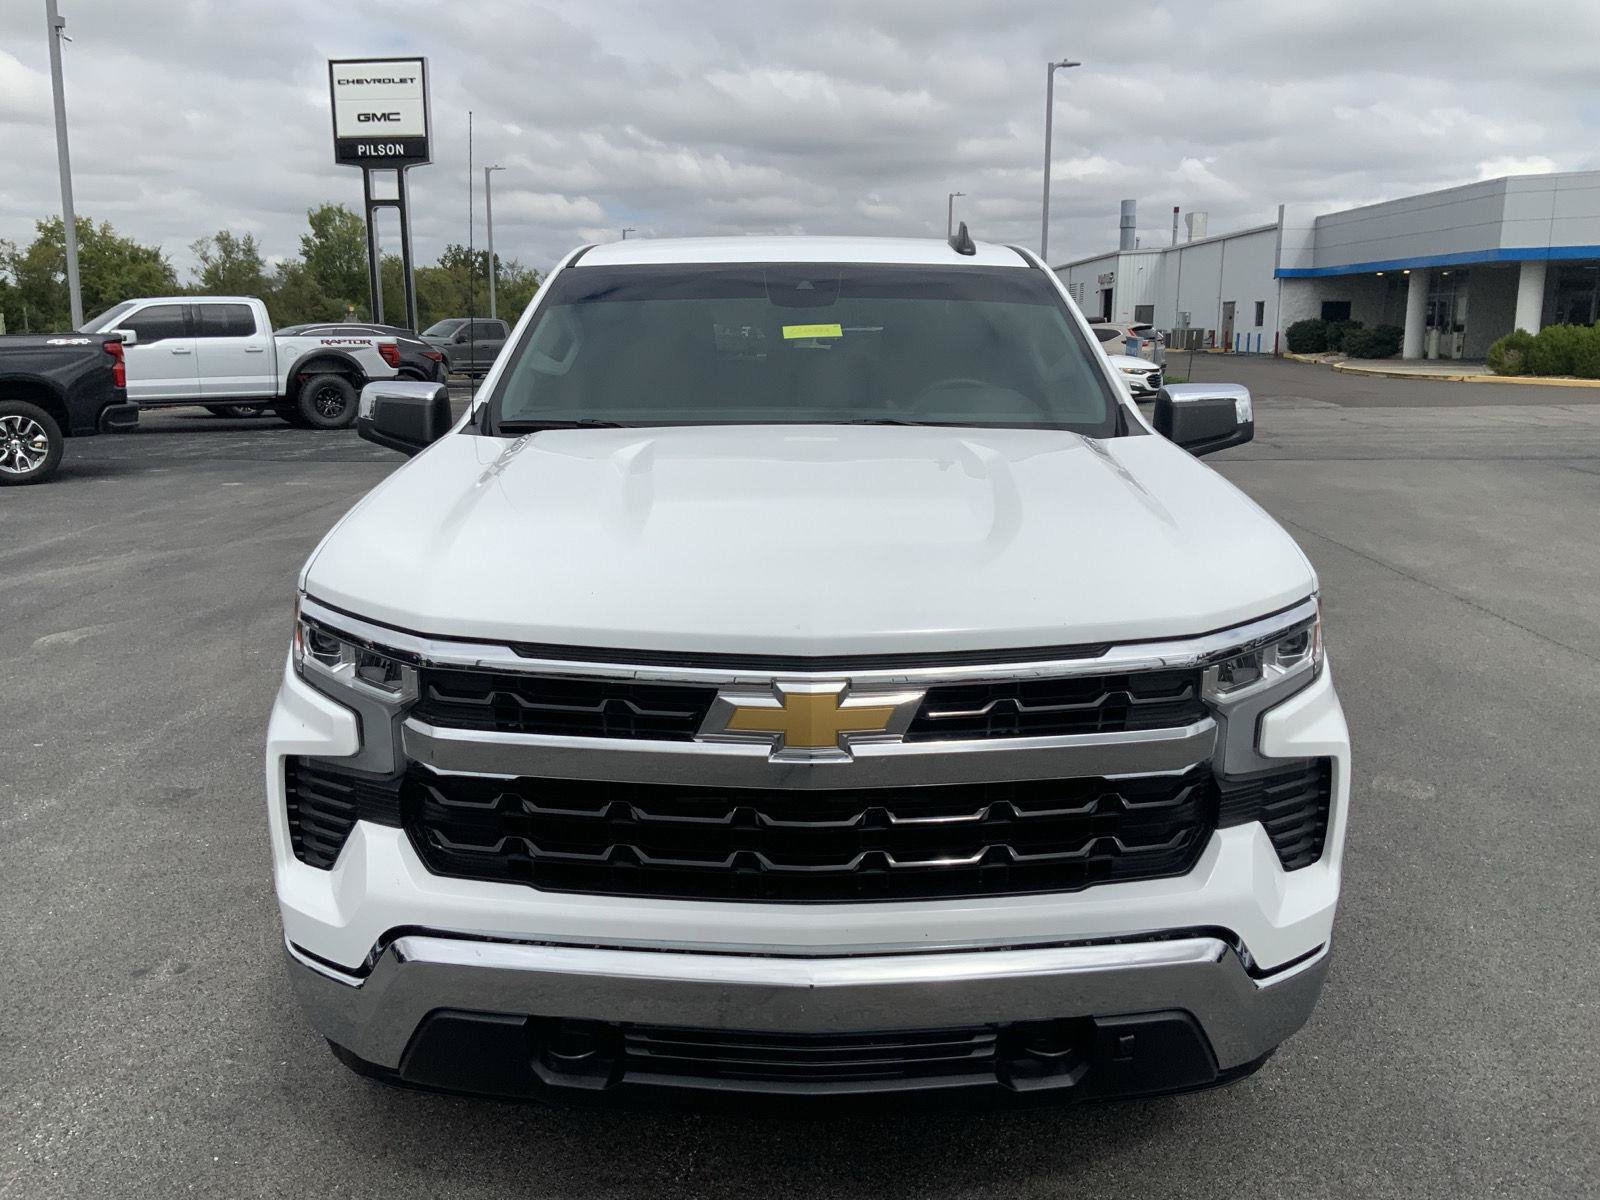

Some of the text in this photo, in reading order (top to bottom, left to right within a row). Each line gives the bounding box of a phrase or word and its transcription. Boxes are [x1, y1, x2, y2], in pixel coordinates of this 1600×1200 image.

[337, 77, 416, 86] CHEVROLET
[357, 112, 401, 122] GMC
[358, 144, 404, 156] PILSON
[320, 339, 374, 347] RAPTOR
